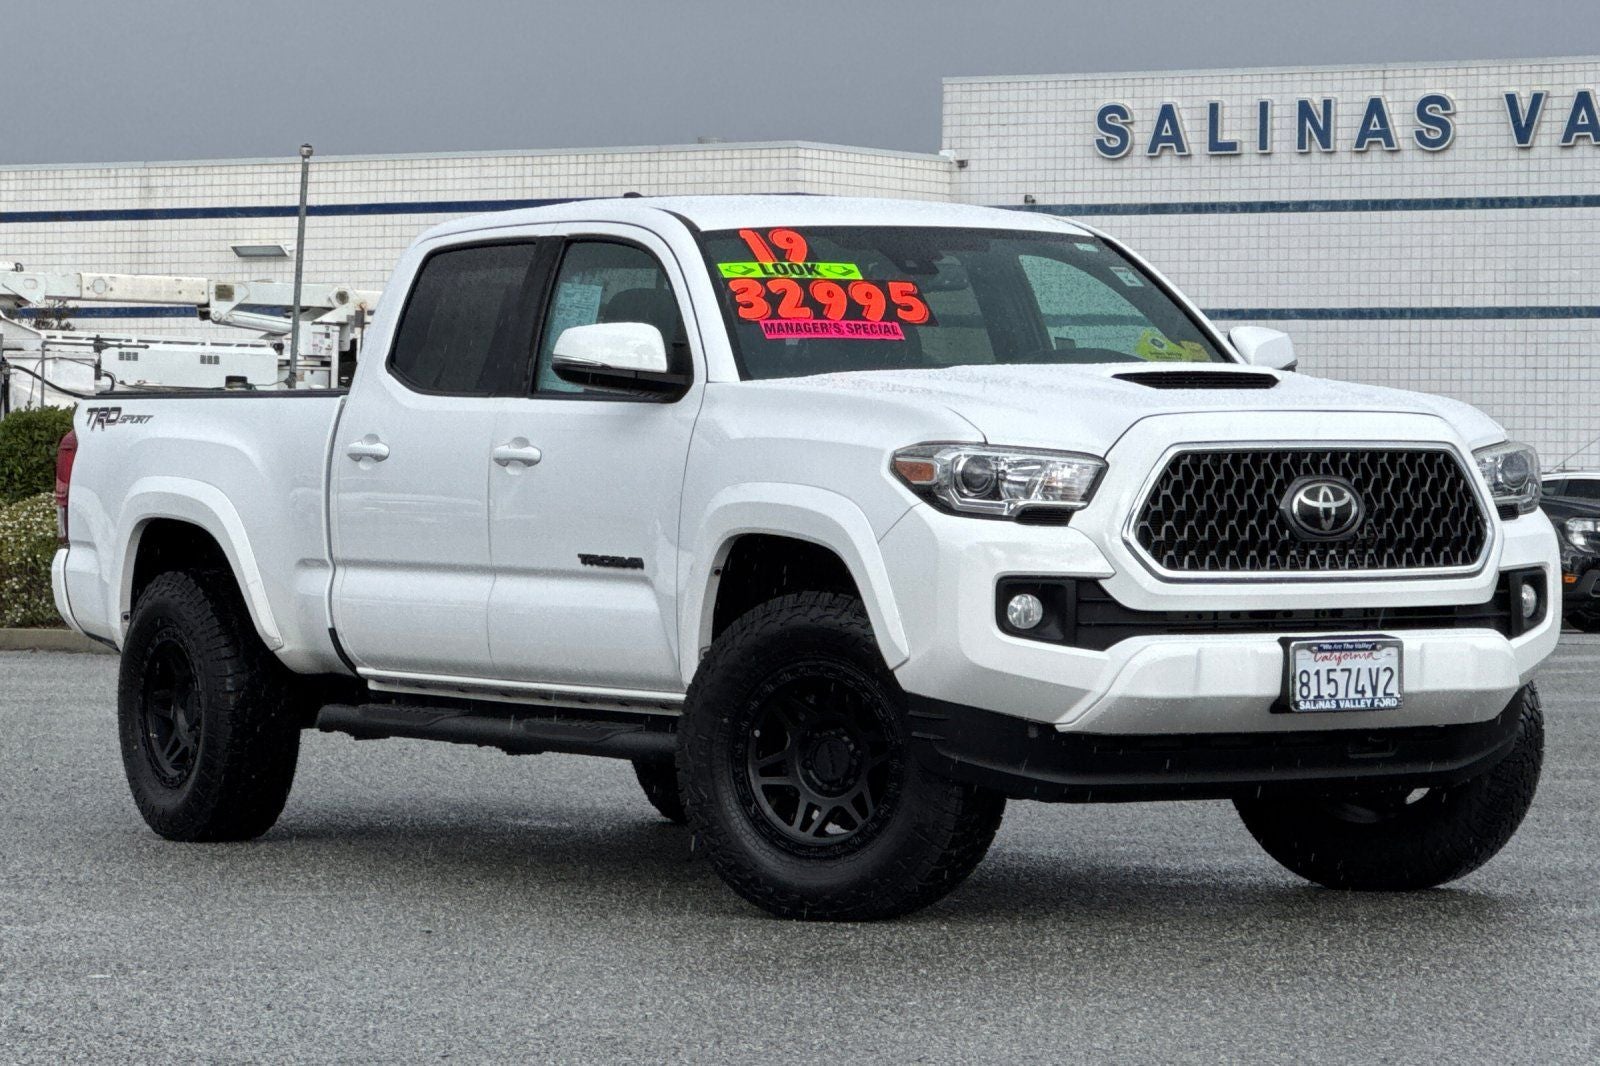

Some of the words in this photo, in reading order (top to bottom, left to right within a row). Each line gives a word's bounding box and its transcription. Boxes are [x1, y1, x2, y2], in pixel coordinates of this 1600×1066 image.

[1095, 93, 1456, 158] SALINAS
[1502, 89, 1600, 148] VA
[738, 227, 808, 263] 19
[758, 262, 824, 277] LOOK
[728, 278, 929, 323] 32995
[763, 321, 843, 335] MANAGER'S
[846, 323, 900, 336] SPECIAL
[87, 406, 122, 431] TRD
[119, 414, 153, 425] SPORT
[1313, 651, 1381, 665] California
[1299, 666, 1395, 699] 81574V2
[1299, 700, 1337, 710] SALINAS
[1339, 699, 1372, 709] VALLEY
[1374, 697, 1398, 708] FORD
